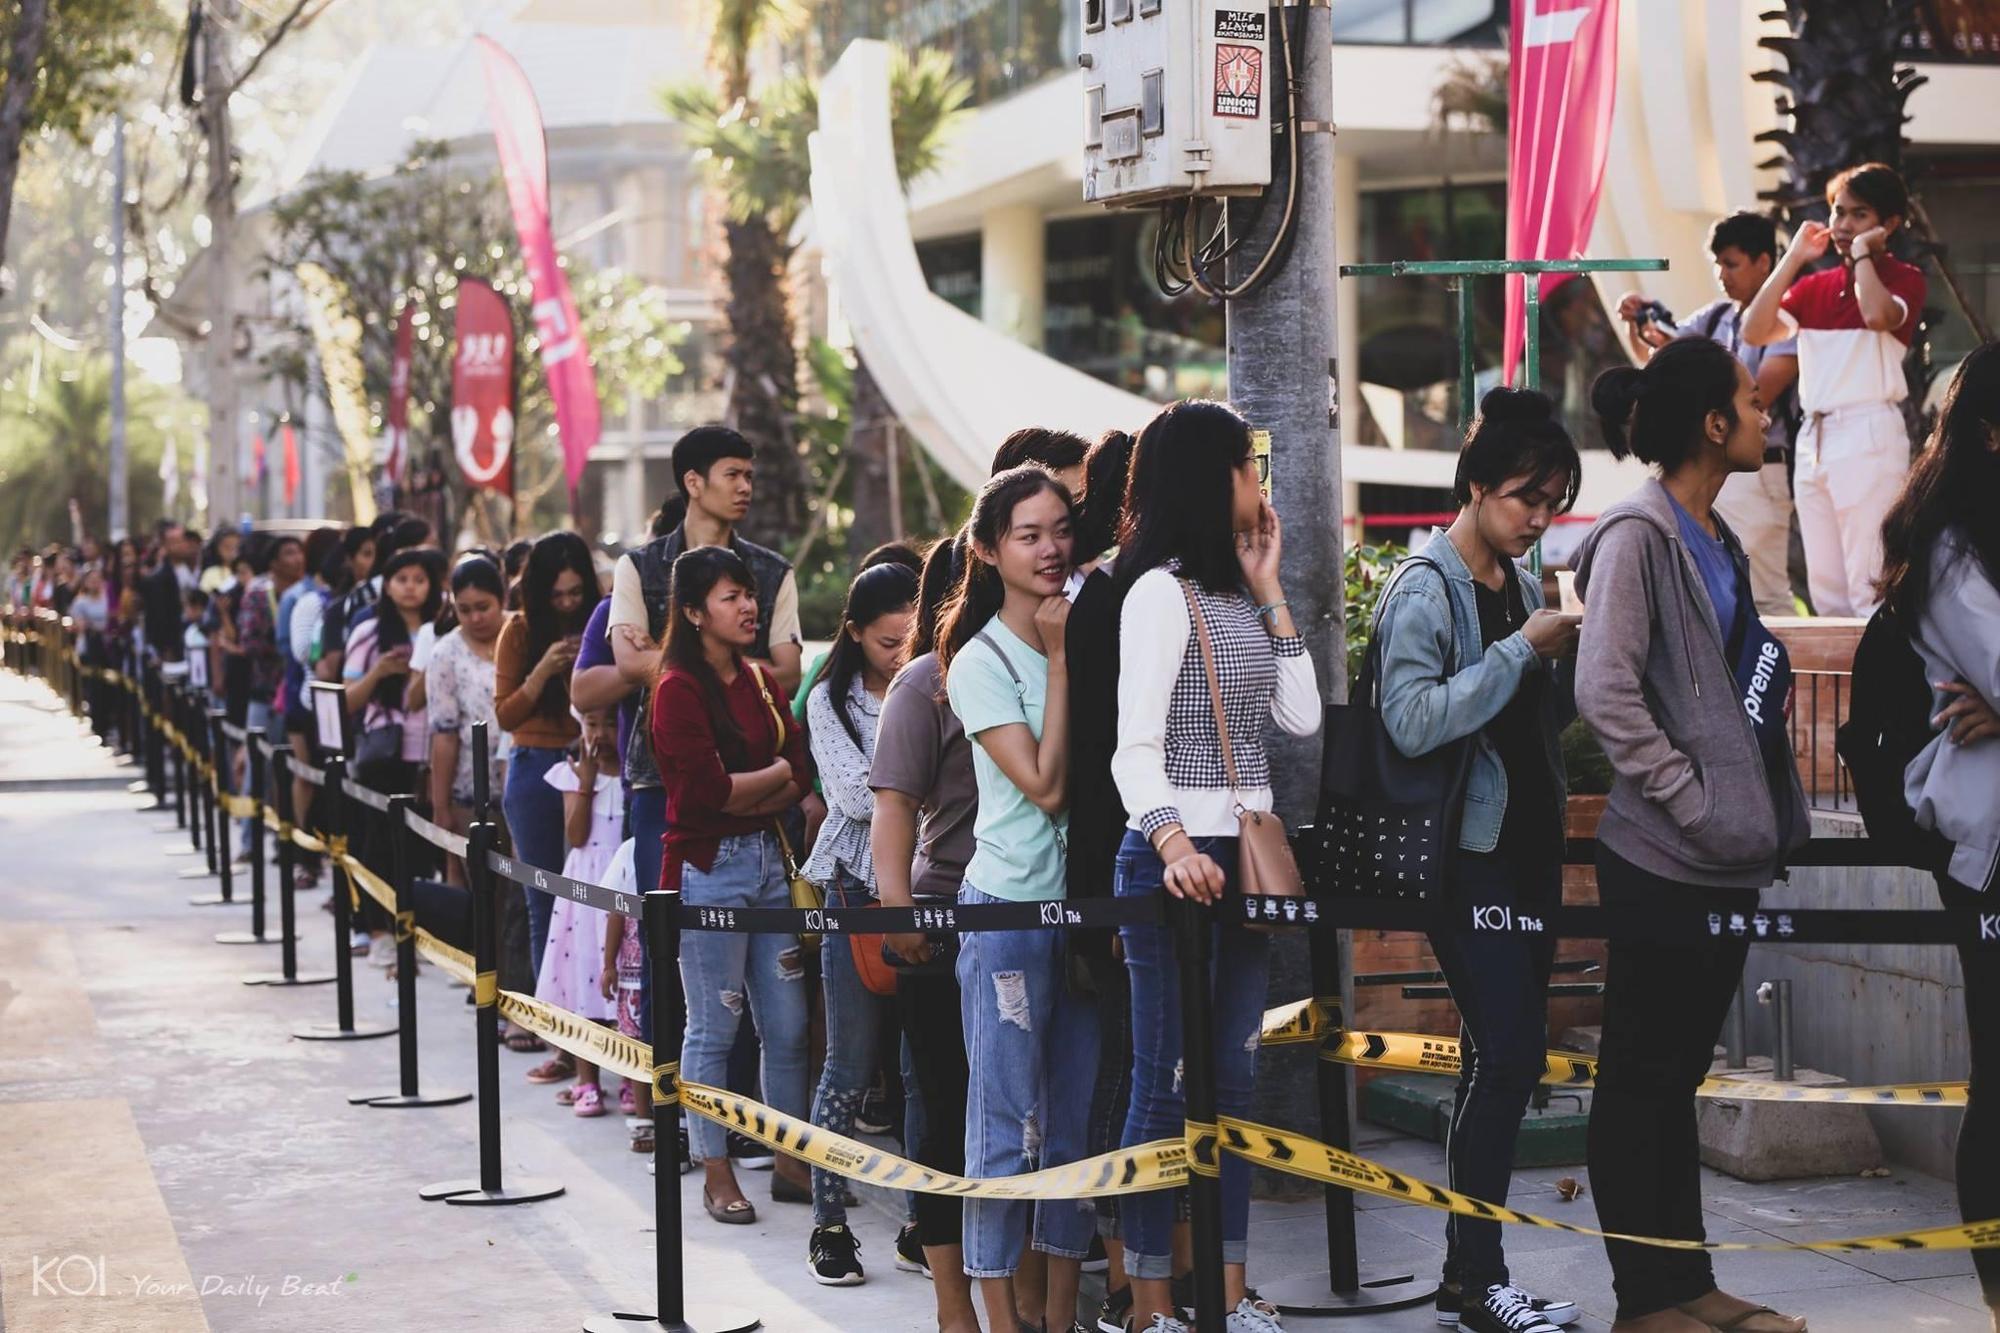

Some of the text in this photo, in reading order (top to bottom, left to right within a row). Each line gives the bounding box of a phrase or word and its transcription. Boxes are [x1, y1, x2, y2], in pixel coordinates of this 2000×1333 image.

[1228, 11, 1257, 22] MILF
[1217, 96, 1255, 108] UNION
[1217, 105, 1256, 116] BERLIN
[1743, 641, 1780, 725] preme
[804, 909, 825, 930] KOI
[1040, 901, 1064, 925] KOI
[1472, 905, 1512, 931] KOI
[1980, 913, 2000, 940] K
